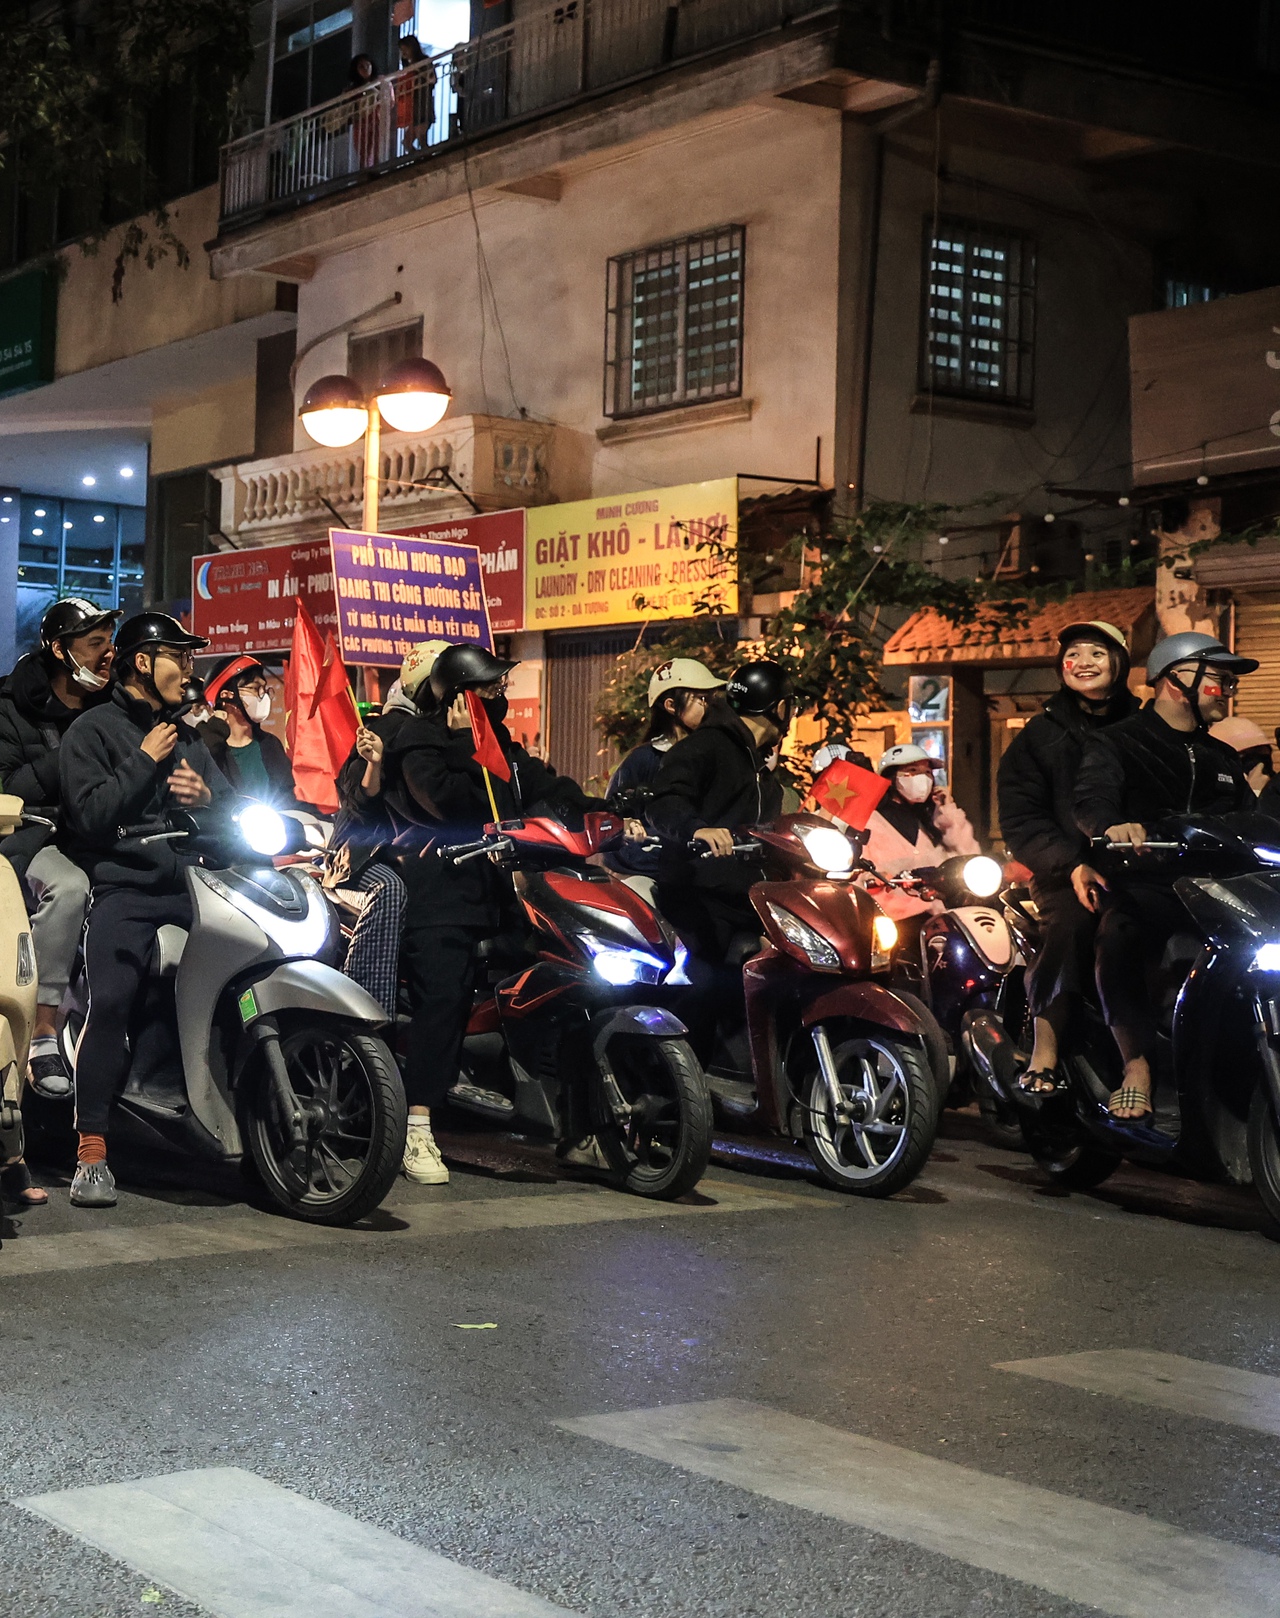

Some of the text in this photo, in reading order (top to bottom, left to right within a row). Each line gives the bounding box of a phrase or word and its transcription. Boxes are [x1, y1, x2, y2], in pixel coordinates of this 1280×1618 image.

[597, 505, 622, 520] MINH
[428, 529, 450, 540] Thanh
[451, 528, 468, 540] Nga
[536, 531, 580, 568] GIẶT
[588, 523, 630, 558] KHÔ
[352, 538, 466, 580] PHỐ TRẦN HƯNG ĐẠO
[268, 579, 279, 598] IN
[339, 577, 480, 610] ĐANG THI CÔNG ĐƯỜNG SẮT
[536, 574, 578, 598] LAUNDRY
[588, 569, 606, 592] DRY
[610, 564, 660, 590] CLEANING
[379, 614, 390, 630] TƯ
[344, 634, 360, 651] CÁC
[362, 638, 392, 654] PHƯƠNG
[921, 680, 940, 710] 2
